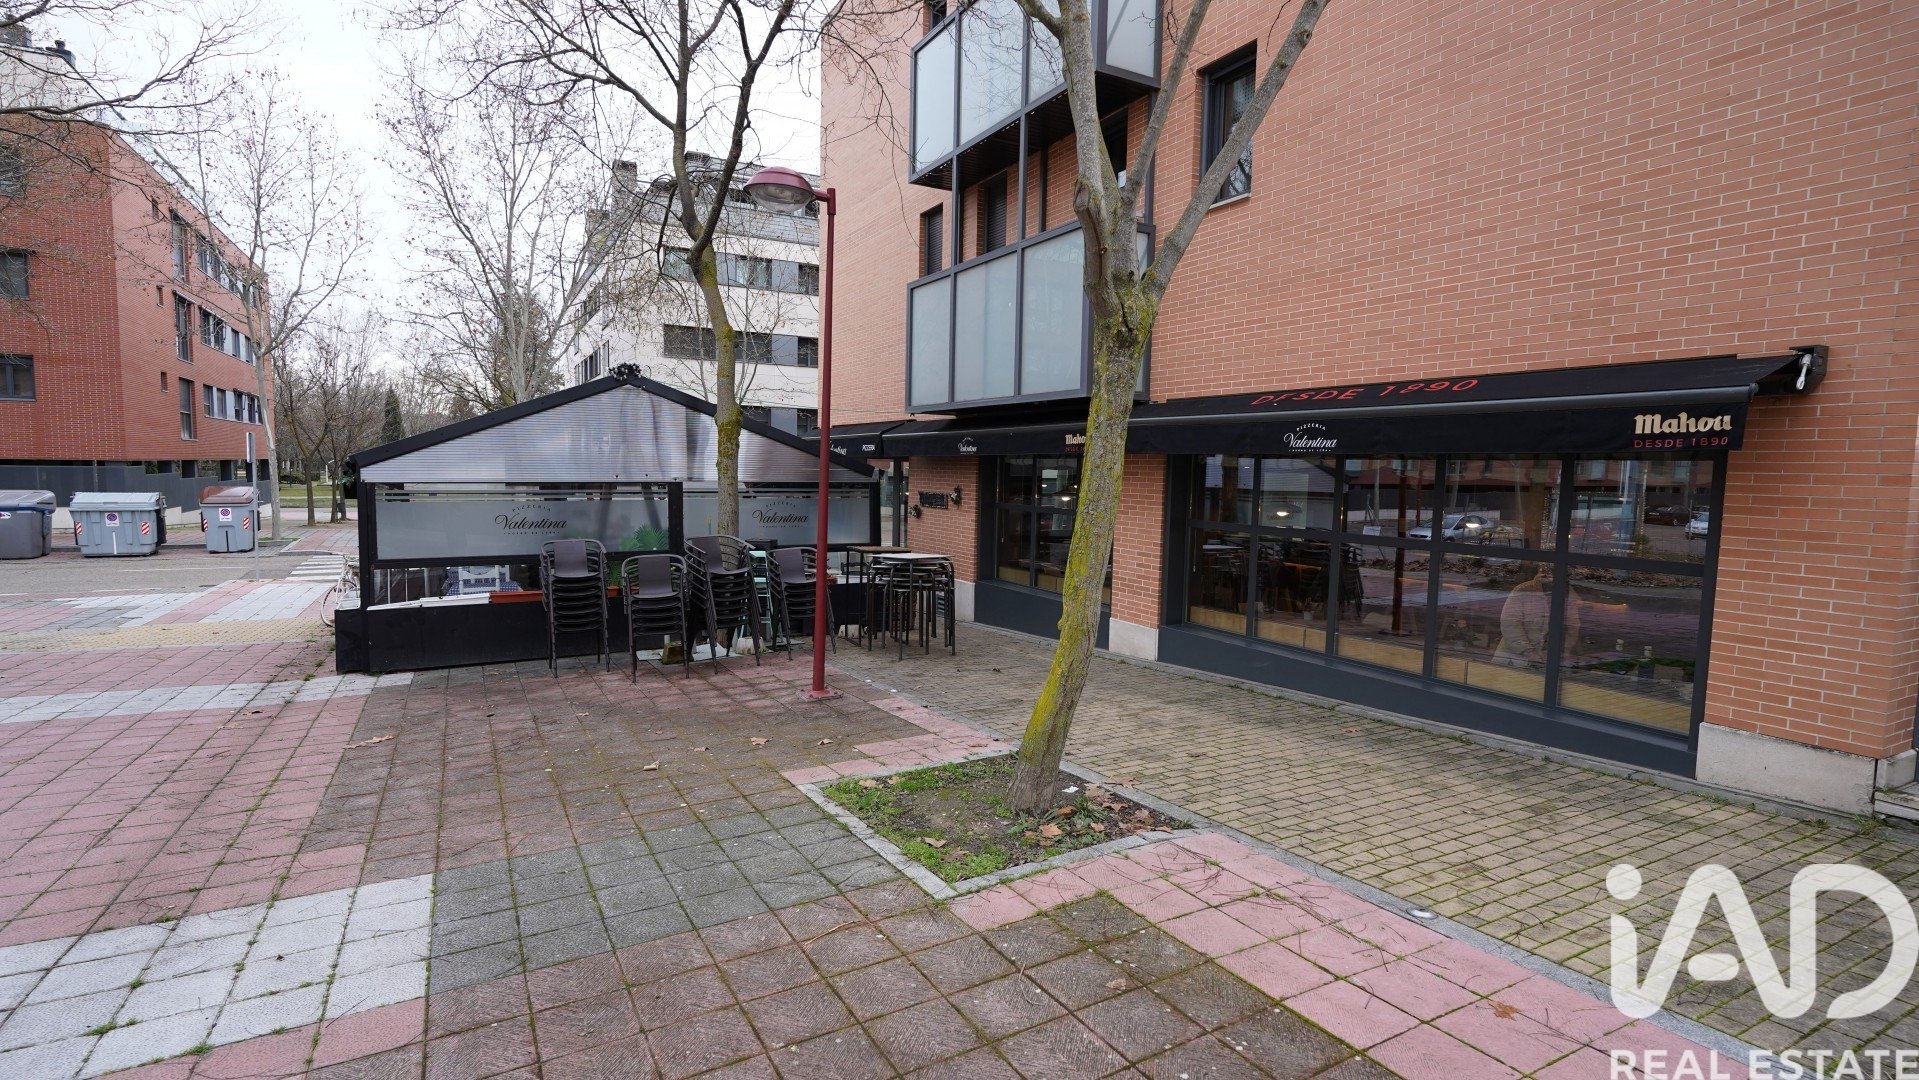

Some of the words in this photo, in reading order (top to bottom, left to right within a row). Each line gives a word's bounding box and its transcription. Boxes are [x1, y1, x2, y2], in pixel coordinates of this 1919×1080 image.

[1250, 388, 1365, 405] DESDE
[1379, 379, 1478, 396] 1890
[1296, 422, 1326, 431] PIZZERIA
[1633, 412, 1733, 434] Mahou
[1065, 433, 1087, 445] Maho
[1283, 432, 1338, 448] Valentina
[1634, 438, 1684, 448] DESDE
[1692, 437, 1729, 446] 1890
[494, 512, 568, 530] Valentina
[752, 508, 809, 524] Valentina
